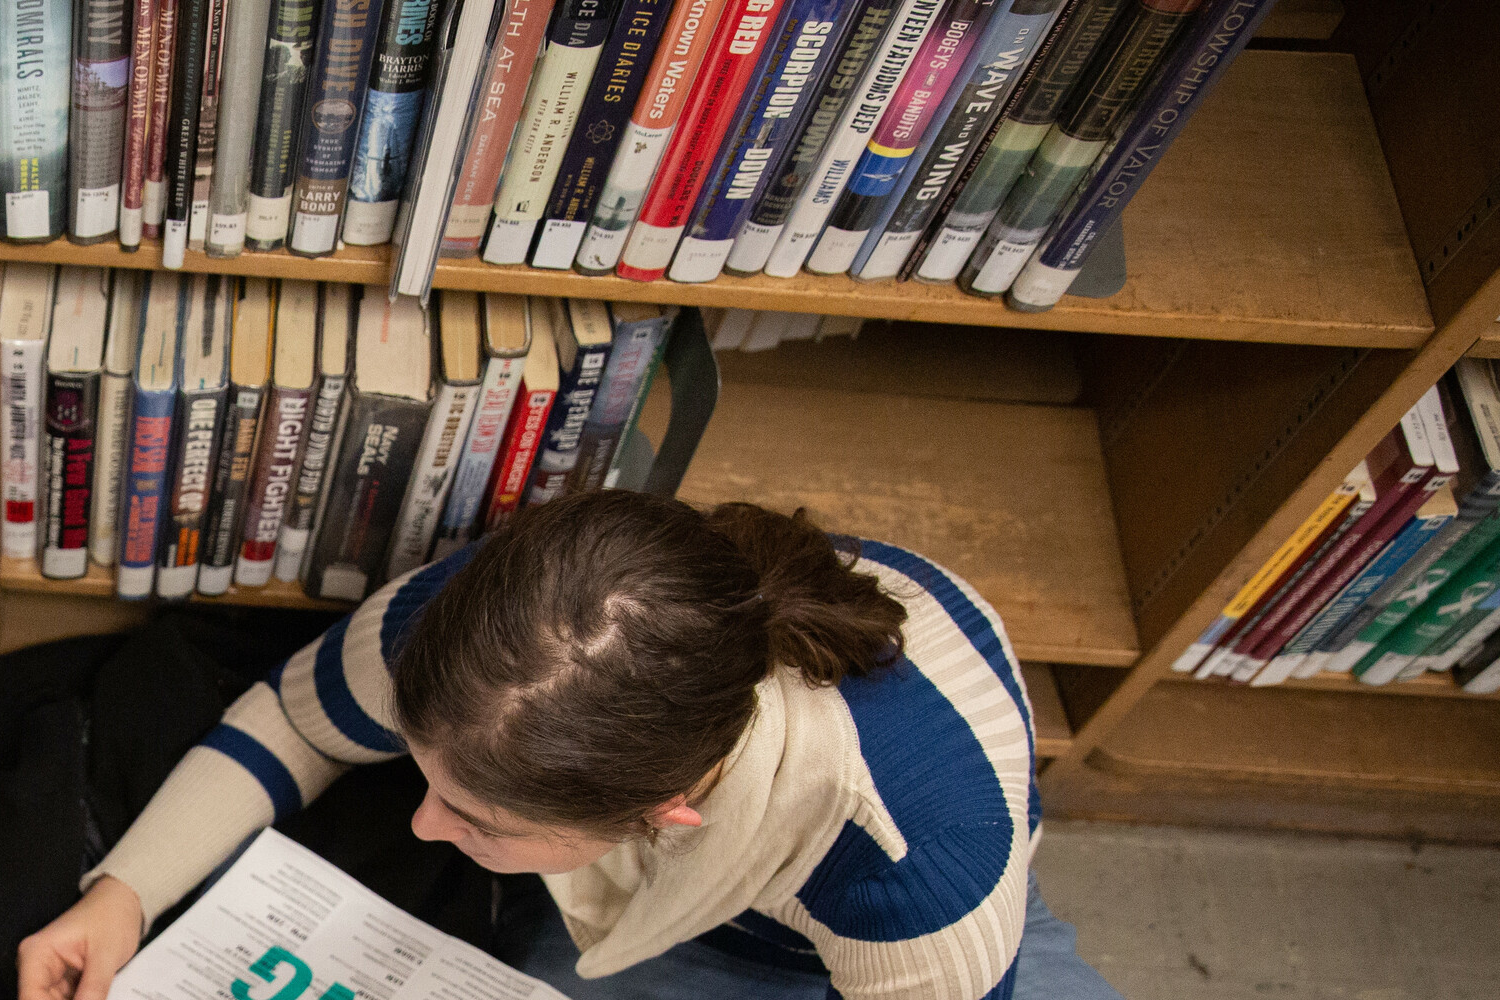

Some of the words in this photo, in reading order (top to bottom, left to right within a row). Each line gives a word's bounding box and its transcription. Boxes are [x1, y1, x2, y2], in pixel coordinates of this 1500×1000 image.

[630, 6, 656, 37] ICE
[728, 8, 767, 60] RED
[1011, 24, 1030, 47] ON
[155, 10, 174, 102] MEN-OF-WAR
[322, 38, 364, 92] DIVE
[379, 53, 430, 64] BRAYTON
[495, 45, 516, 73] AT
[828, 5, 889, 95] HANDS
[928, 16, 968, 73] BOGEYS
[1115, 16, 1177, 97] INTREPID
[132, 26, 152, 118] MEN-OF-WAR
[383, 63, 424, 73] HARRIS
[603, 41, 641, 103] DIARIES
[648, 55, 687, 123] Waters
[761, 12, 834, 127] SCORPION
[865, 40, 912, 106] FATHOMS
[963, 37, 1024, 123] WAVE
[480, 80, 506, 125] SEA
[537, 98, 547, 115] WITH
[552, 68, 577, 116] WILLIAM
[891, 85, 932, 143] BANDITS
[179, 118, 190, 147] GREAT
[531, 118, 541, 132] DON
[547, 117, 560, 131] R.
[791, 92, 846, 166] DOWN
[848, 101, 879, 136] DEEP
[957, 114, 978, 141] AND
[1148, 103, 1178, 137] OF
[177, 151, 186, 179] WHITE
[474, 134, 487, 155] DAN
[523, 134, 535, 154] KEITH
[529, 132, 554, 184] ANDERSON
[468, 157, 481, 178] VAN
[576, 155, 595, 188] WILLIAM
[724, 139, 773, 208] DOWN
[812, 157, 850, 207] WILLIAMS
[915, 132, 968, 207] WING
[1097, 134, 1160, 215] VALOR
[174, 182, 184, 208] FLEET
[300, 189, 341, 202] LARRY
[301, 200, 336, 213] BOND
[188, 397, 216, 431] ONE
[554, 384, 594, 454] OPERATOR
[179, 428, 211, 492] PERFECT
[375, 424, 398, 466] NAVY
[518, 431, 534, 449] ON
[503, 448, 528, 494] TARGET
[254, 461, 291, 544] FIGHTER
